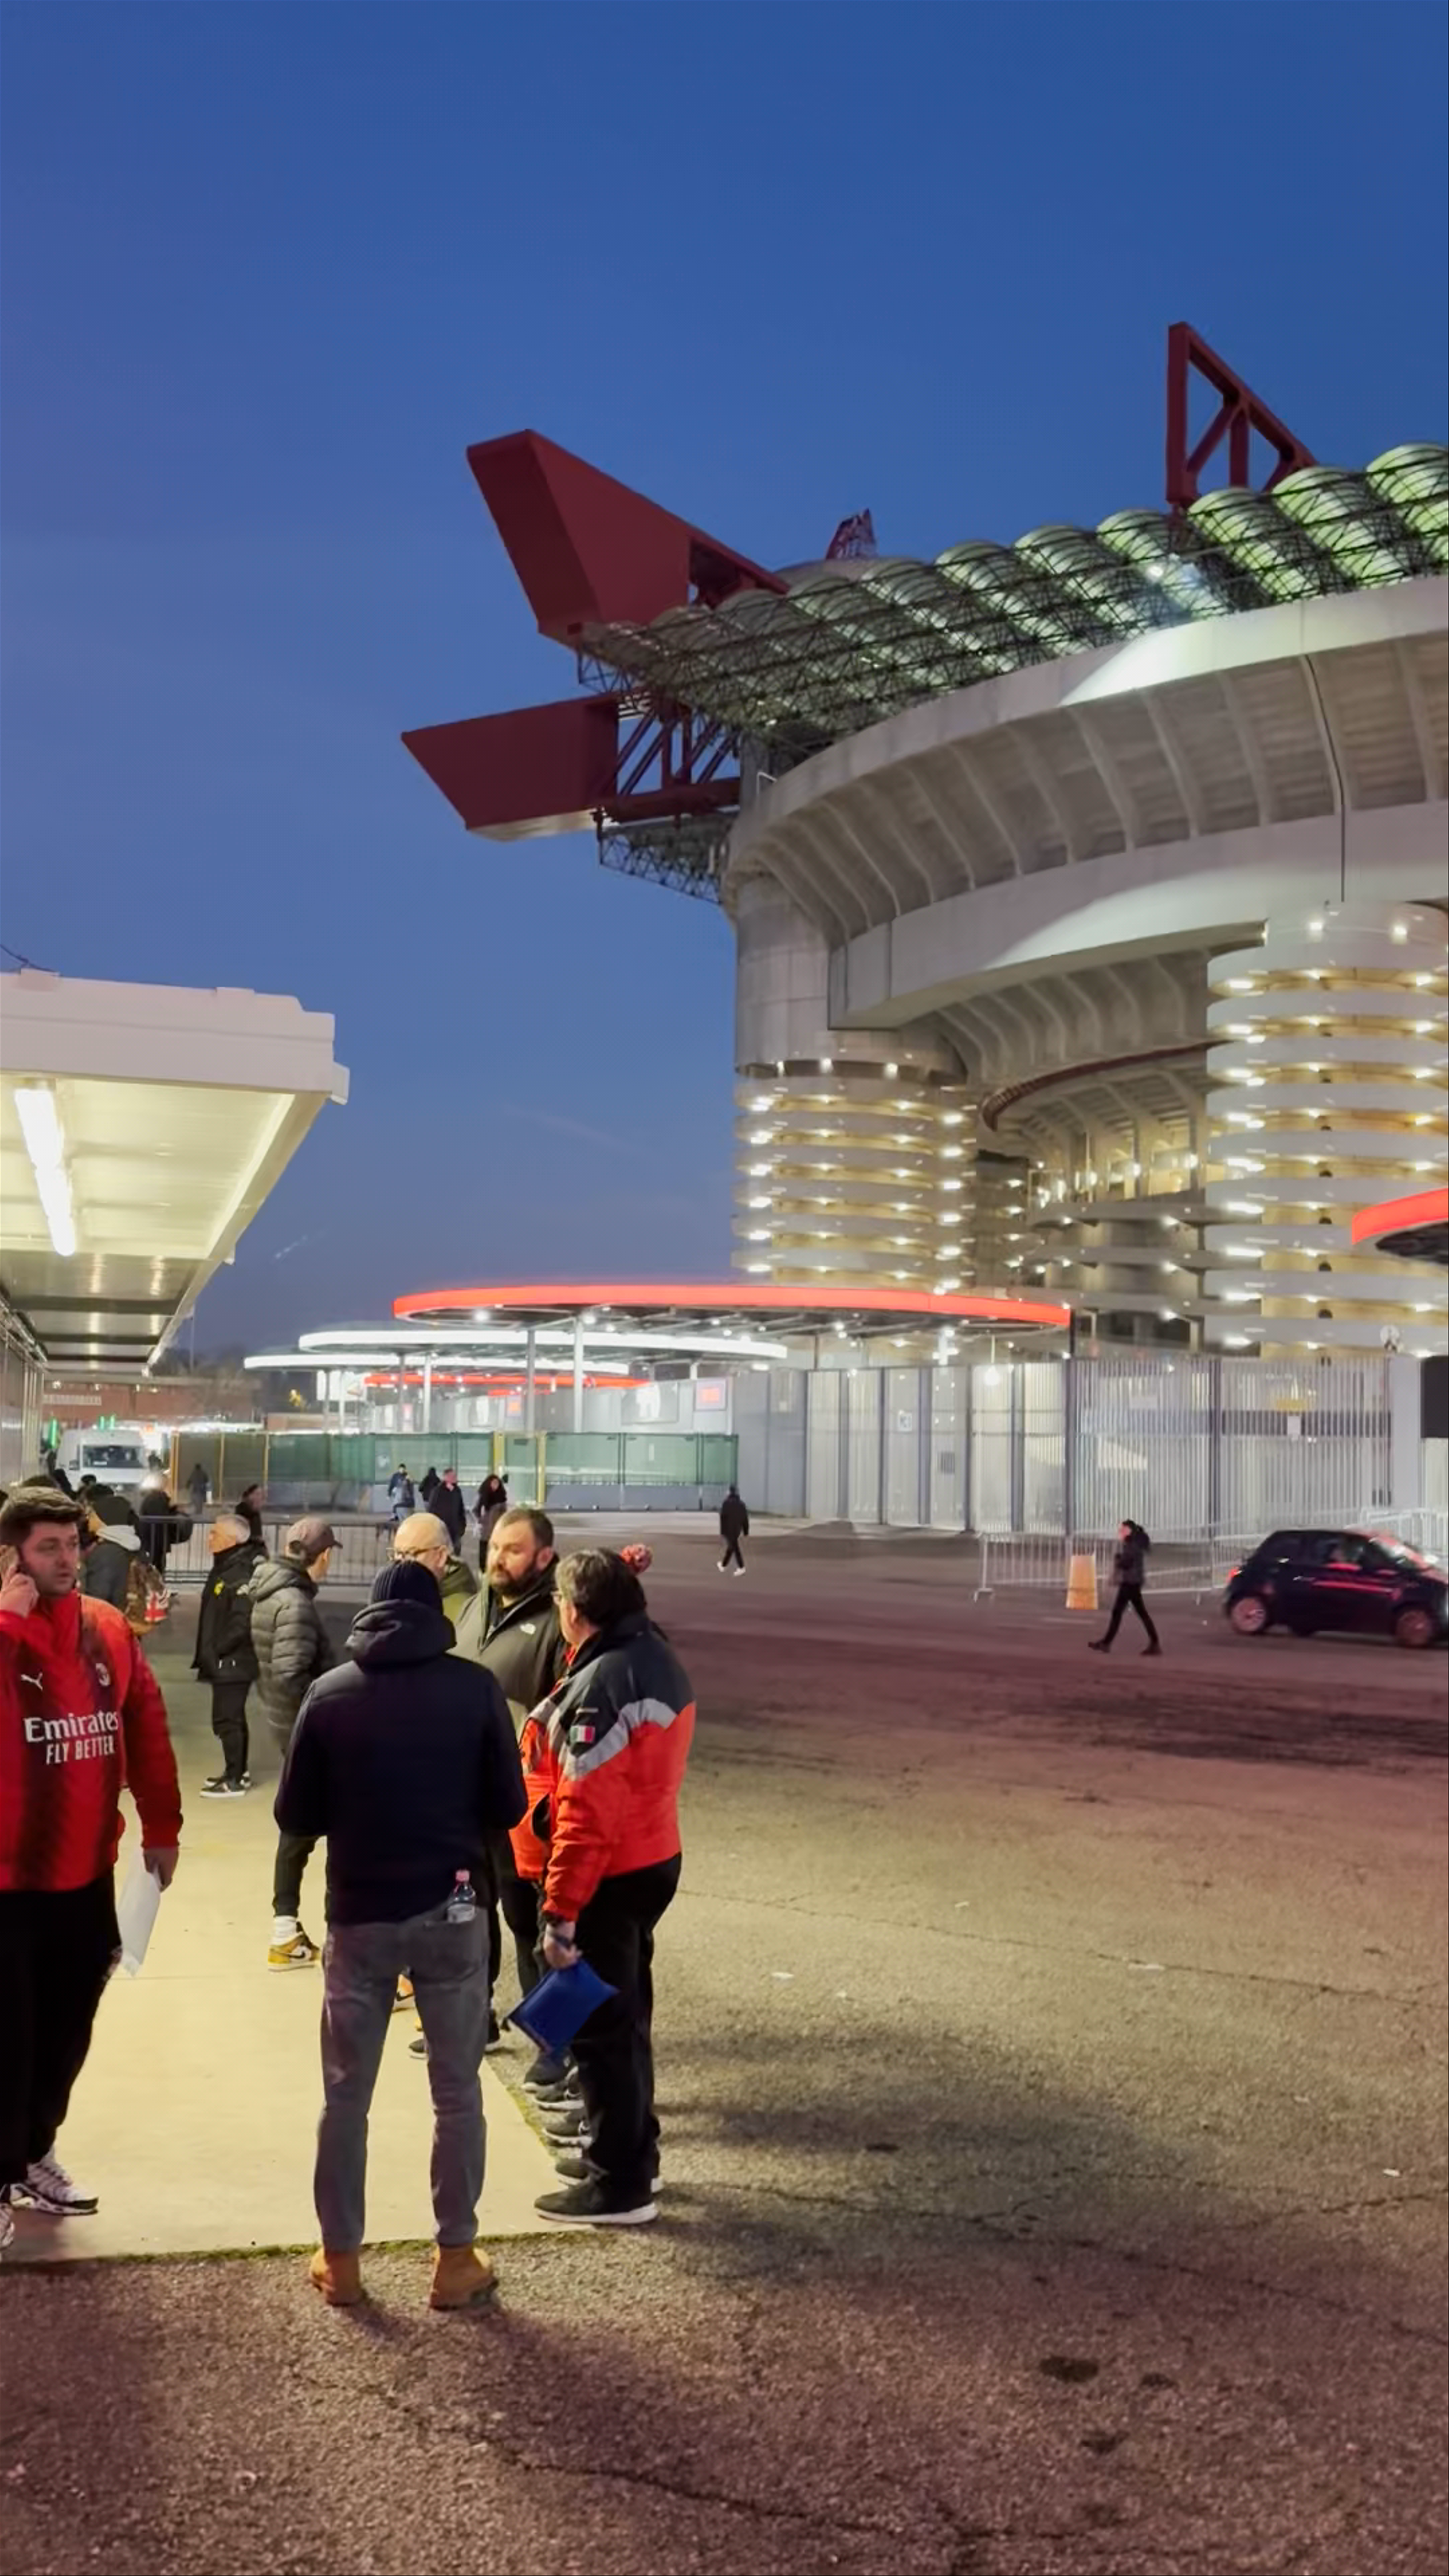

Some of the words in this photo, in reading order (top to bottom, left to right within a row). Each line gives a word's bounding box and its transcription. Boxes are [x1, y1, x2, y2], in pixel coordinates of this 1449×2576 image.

[24, 1710, 118, 1742] Emirates
[46, 1741, 69, 1765] FLY
[75, 1735, 115, 1760] BETTER
